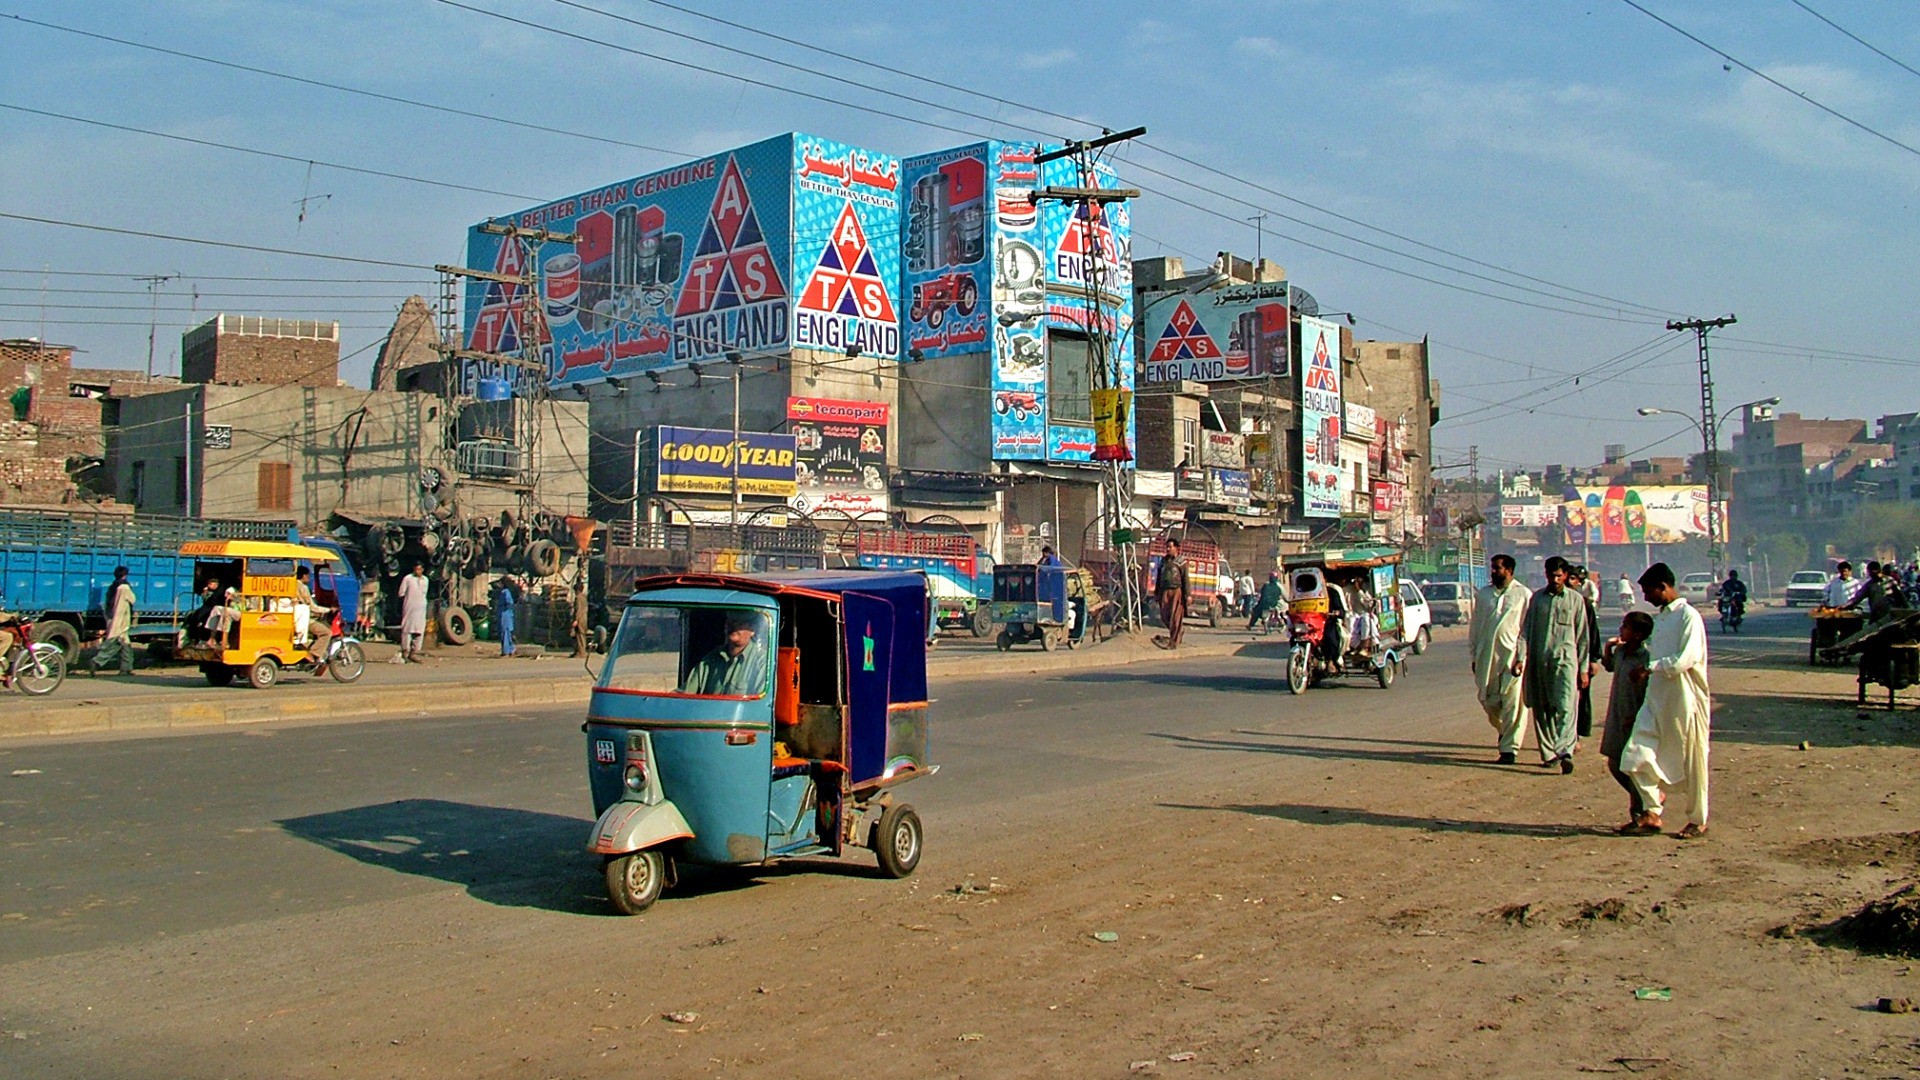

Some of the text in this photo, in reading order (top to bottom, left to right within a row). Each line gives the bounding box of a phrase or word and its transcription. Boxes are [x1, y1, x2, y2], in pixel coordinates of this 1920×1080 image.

[522, 161, 715, 229] BETTER THAN GENUINE
[801, 180, 894, 208] BETTER THAN GENUINE
[1259, 285, 1287, 298] حافظ
[673, 301, 788, 361] ENGLAND
[796, 311, 898, 356] ENGLAND
[1147, 361, 1224, 382] ENGLAND
[815, 403, 881, 419] tecnopart
[1305, 390, 1339, 414] ENGLAND
[251, 578, 289, 592] QINGQI
